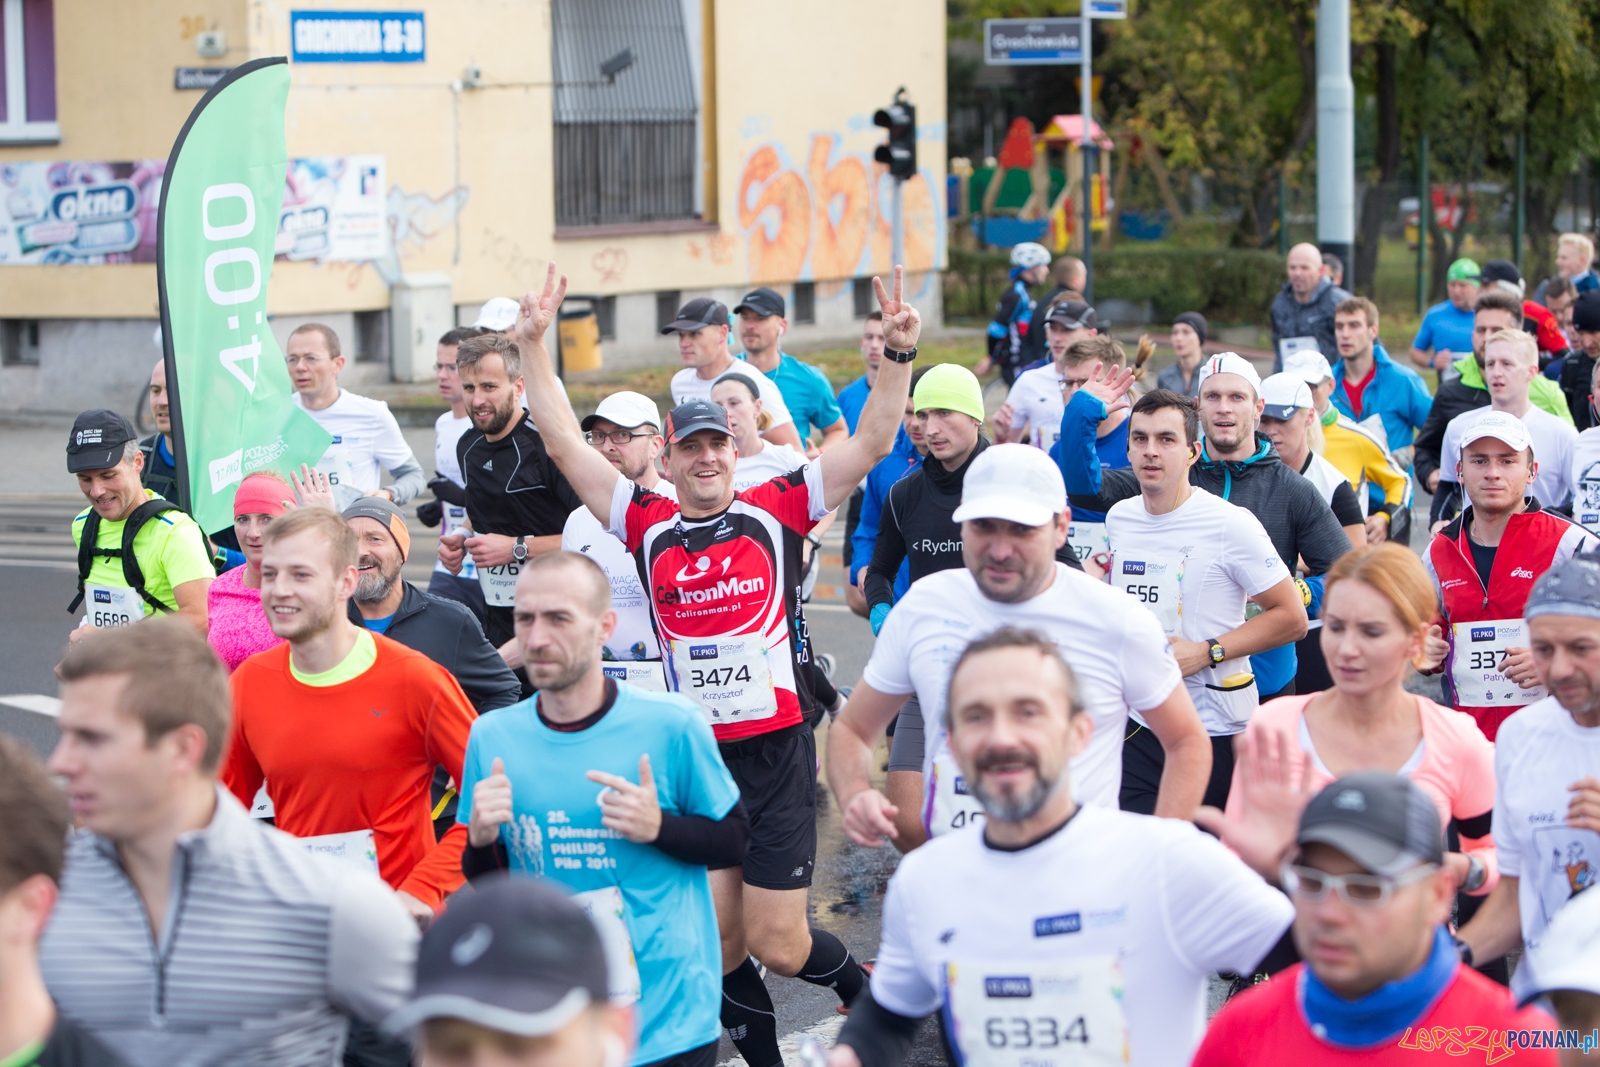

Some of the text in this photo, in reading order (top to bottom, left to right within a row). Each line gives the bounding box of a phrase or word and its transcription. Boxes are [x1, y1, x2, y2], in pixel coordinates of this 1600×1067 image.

[992, 33, 1080, 50] Grochowska
[58, 188, 127, 219] okna
[202, 182, 262, 396] 4:00
[244, 443, 290, 472] maraton
[214, 458, 240, 484] 17.PKO
[1125, 564, 1144, 572] 17.PKO
[609, 575, 640, 585] WAGA
[656, 576, 765, 605] CelIronMan
[675, 602, 742, 619] Celironman.pl
[1473, 630, 1494, 638] 17.PKO
[691, 648, 716, 657] 17.PKO
[1470, 650, 1513, 670] 337
[691, 664, 752, 688] 3474
[1483, 673, 1509, 682] Patry
[702, 688, 744, 701] Krzysztof
[547, 810, 571, 824] 25.
[548, 826, 626, 840] Półmarato
[550, 842, 607, 856] PHILIPS
[985, 1016, 1091, 1050] 6334
